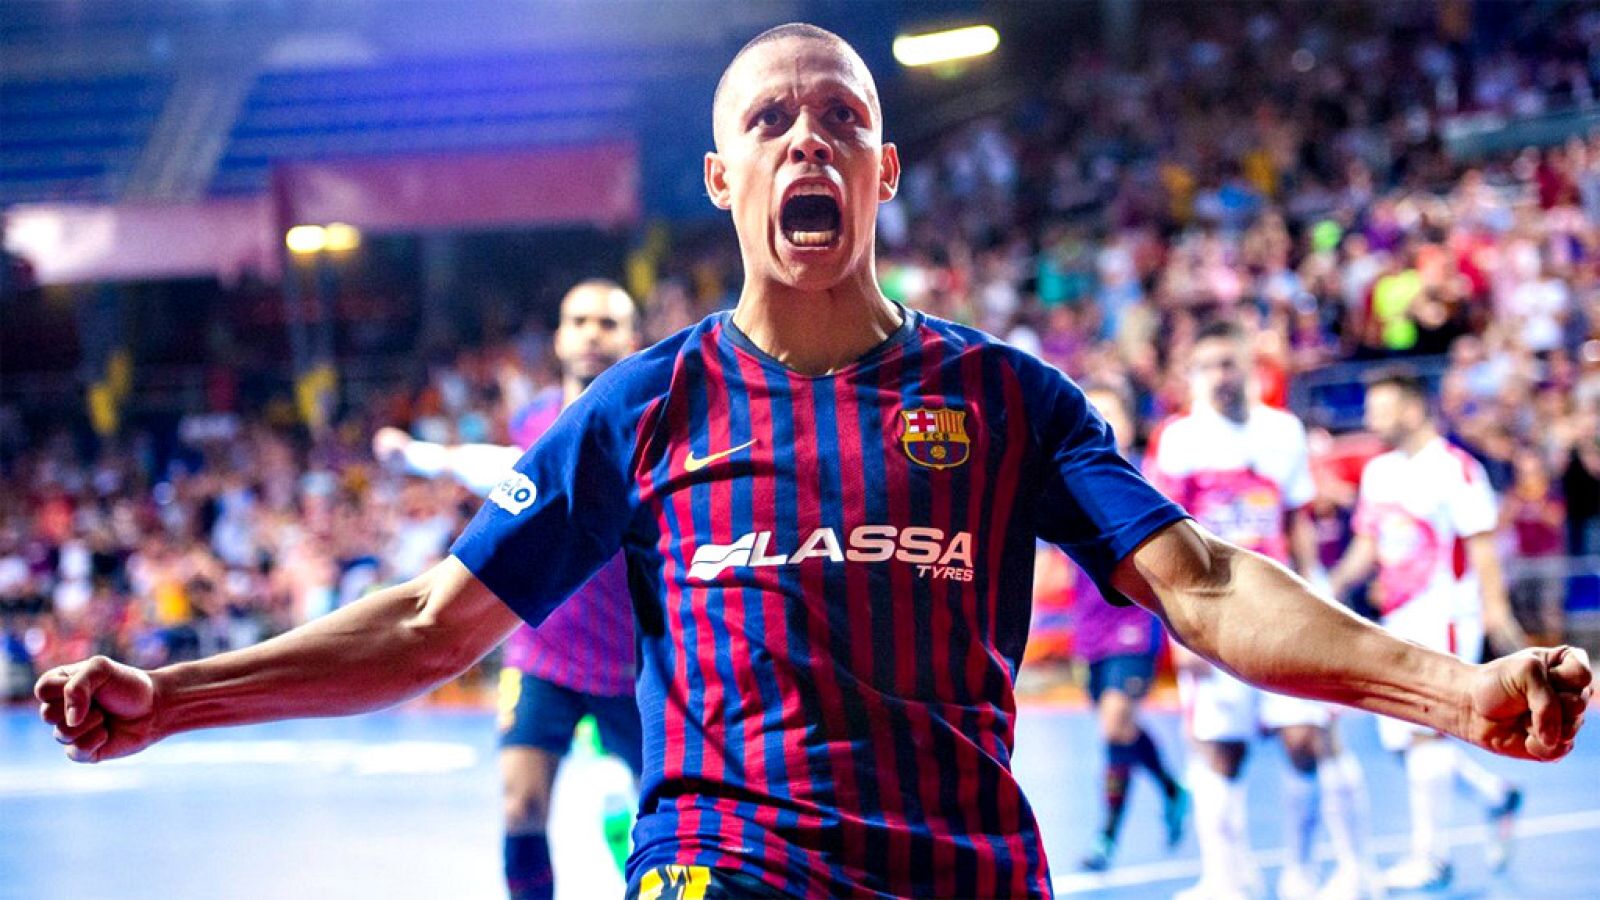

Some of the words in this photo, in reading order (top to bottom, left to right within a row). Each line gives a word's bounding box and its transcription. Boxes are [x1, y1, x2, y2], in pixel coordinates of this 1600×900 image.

[923, 432, 950, 442] FCB
[748, 525, 973, 568] LASSA
[916, 564, 974, 582] TYRES
